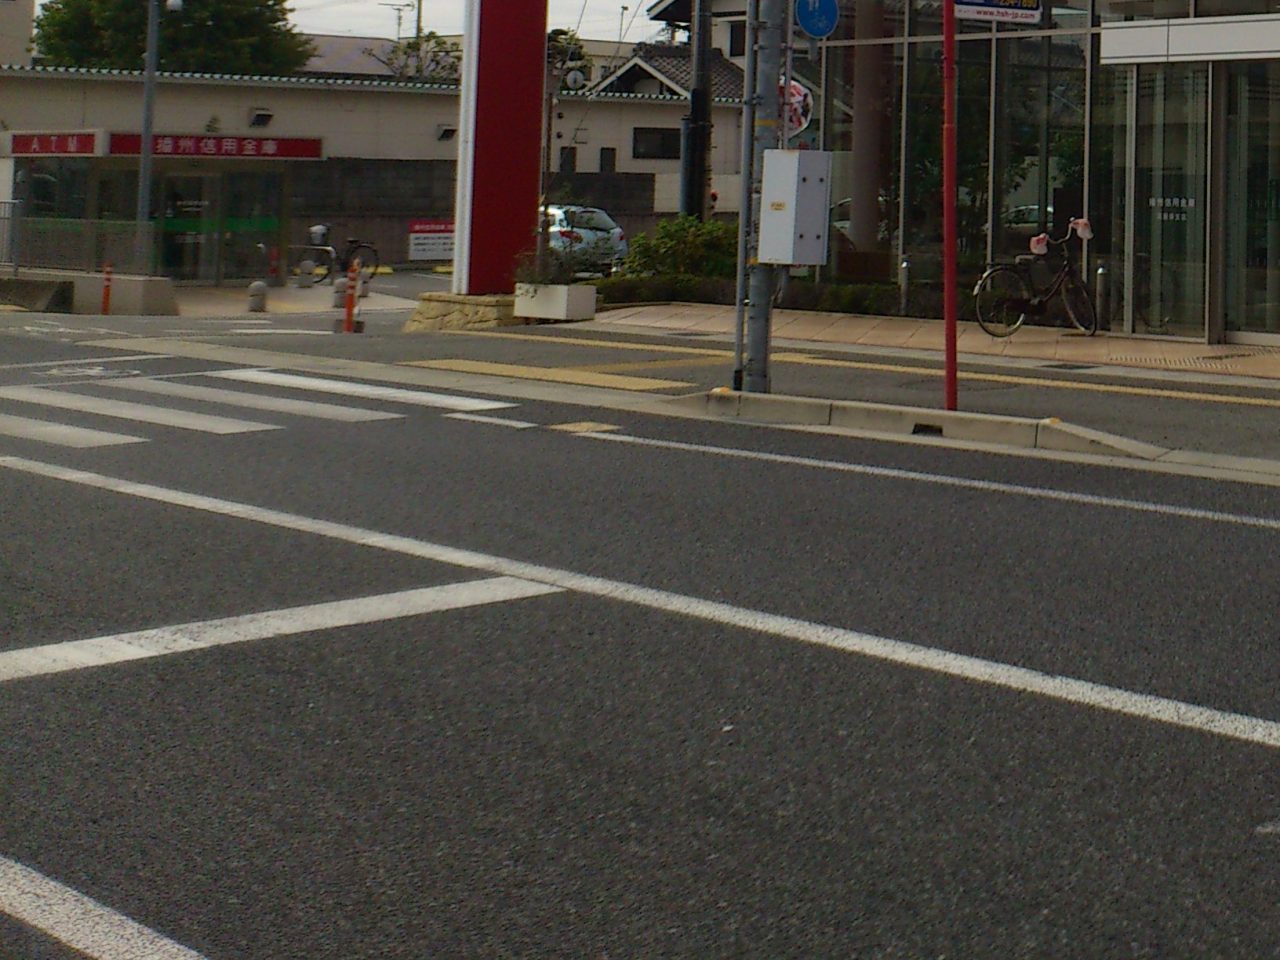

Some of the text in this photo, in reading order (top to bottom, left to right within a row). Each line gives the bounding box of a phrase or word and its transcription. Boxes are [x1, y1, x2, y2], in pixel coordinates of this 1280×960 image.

[155, 137, 278, 154] 播州信用金庫
